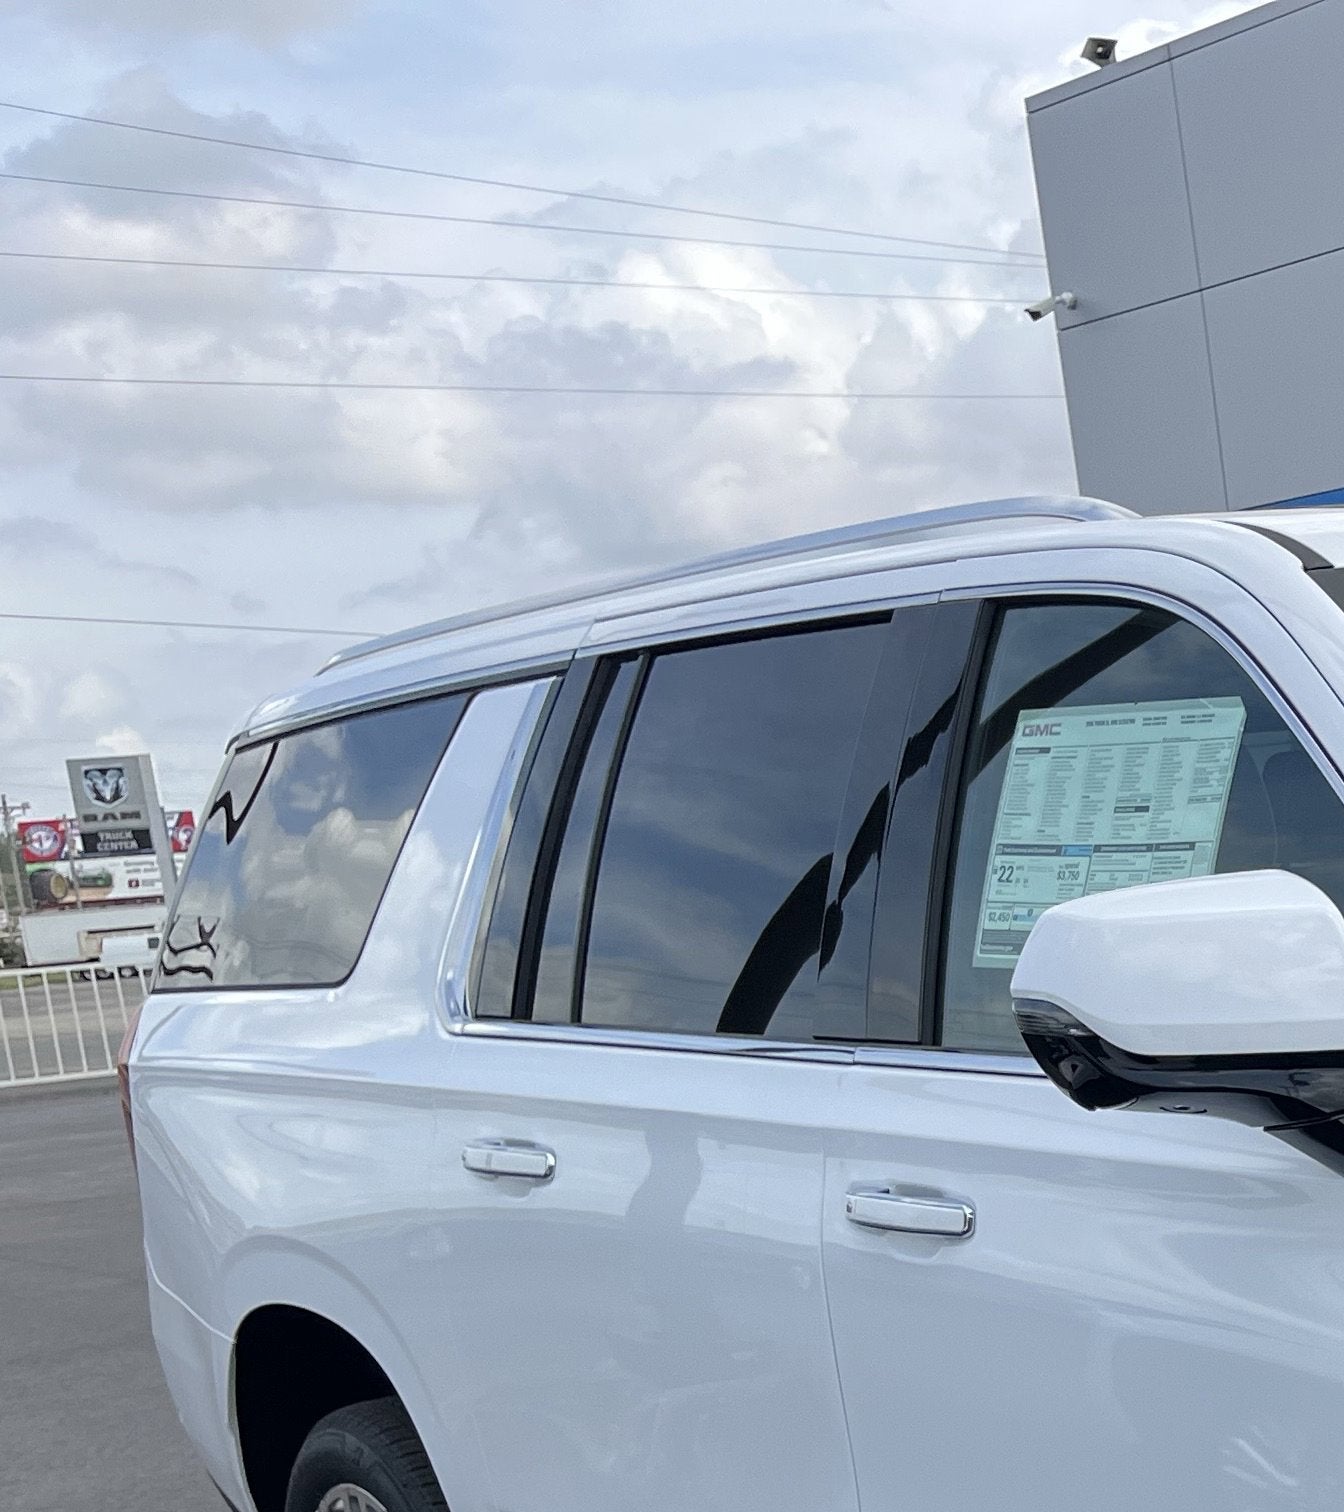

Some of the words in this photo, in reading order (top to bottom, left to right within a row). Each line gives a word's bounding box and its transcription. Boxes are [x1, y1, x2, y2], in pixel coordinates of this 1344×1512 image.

[1022, 722, 1062, 738] GMC
[82, 810, 142, 823] RAM
[98, 830, 134, 841] TRUCK
[96, 840, 138, 851] CENTER
[997, 865, 1014, 883] 22
